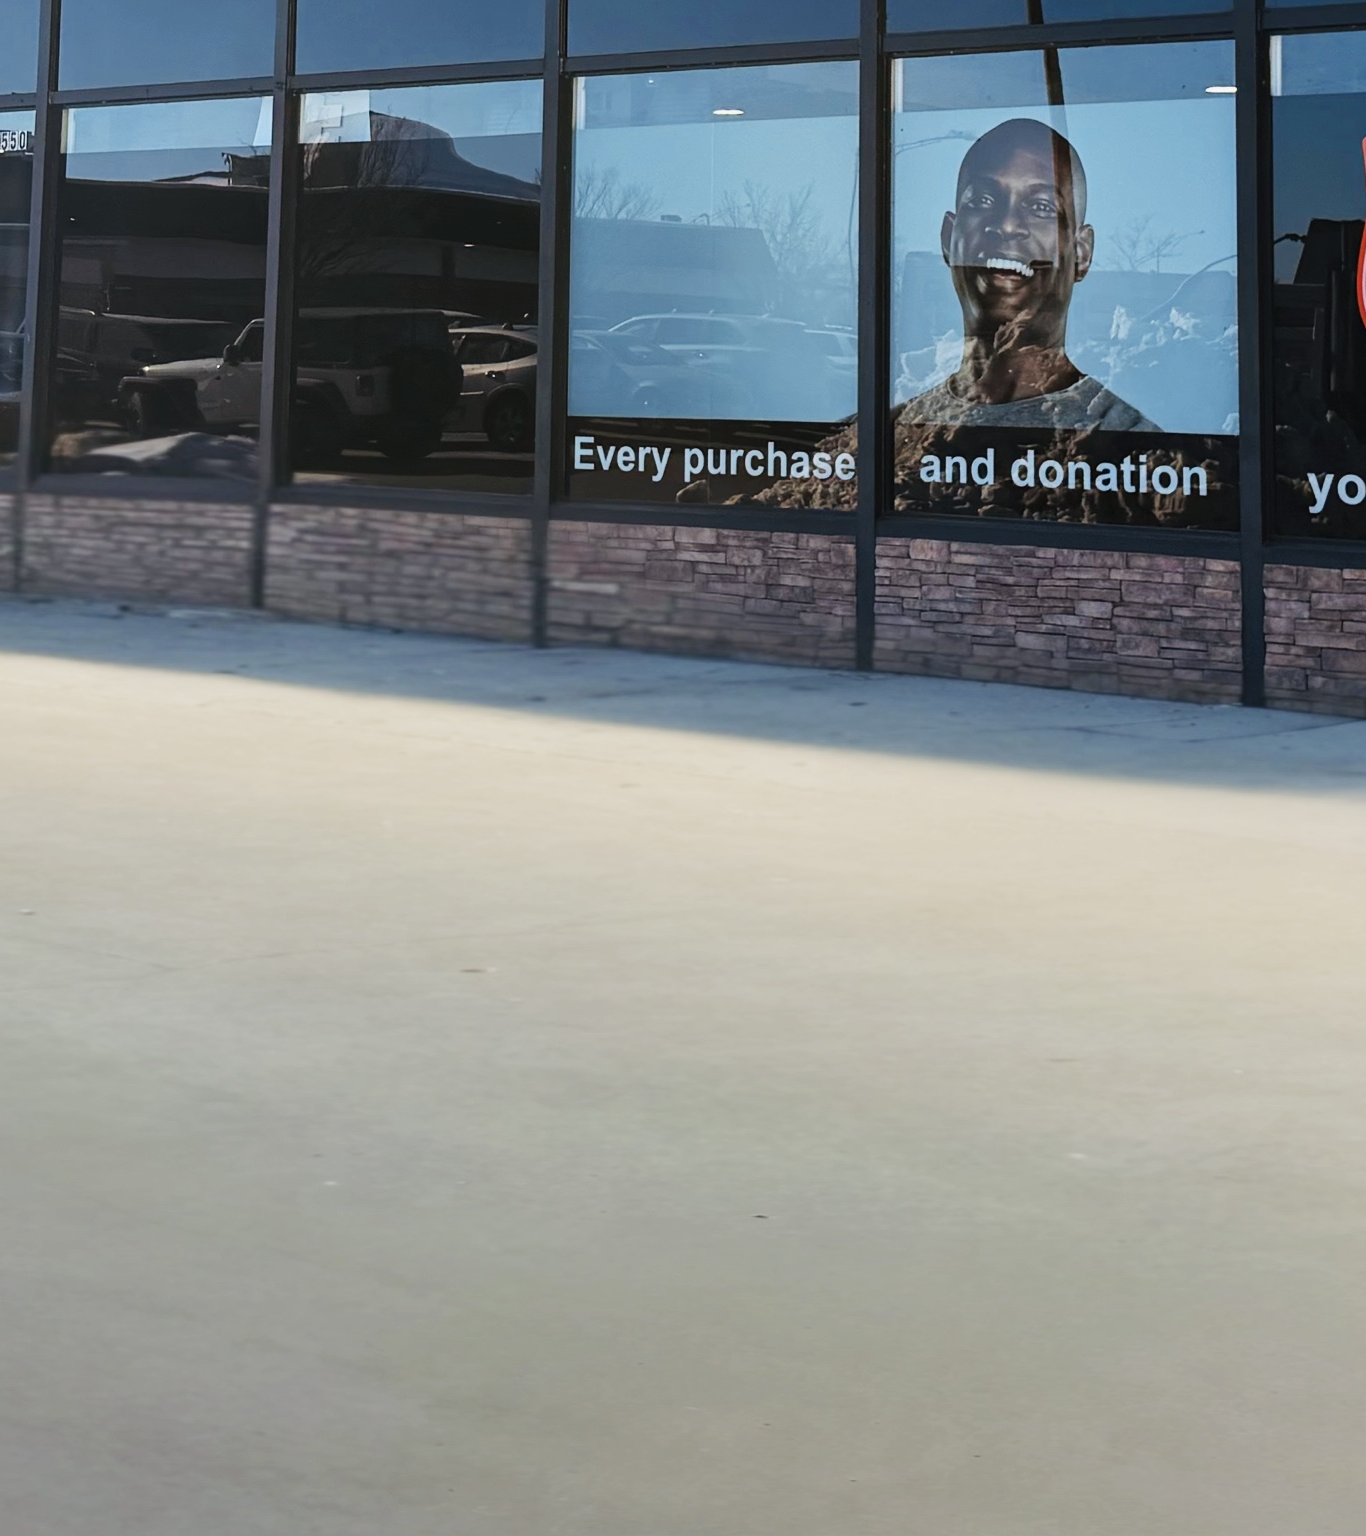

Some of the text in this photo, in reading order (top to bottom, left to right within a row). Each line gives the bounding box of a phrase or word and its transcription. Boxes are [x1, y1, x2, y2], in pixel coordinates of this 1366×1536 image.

[573, 435, 672, 482] Every
[684, 441, 857, 483] purchase
[919, 447, 995, 486] and
[1010, 449, 1208, 496] donation
